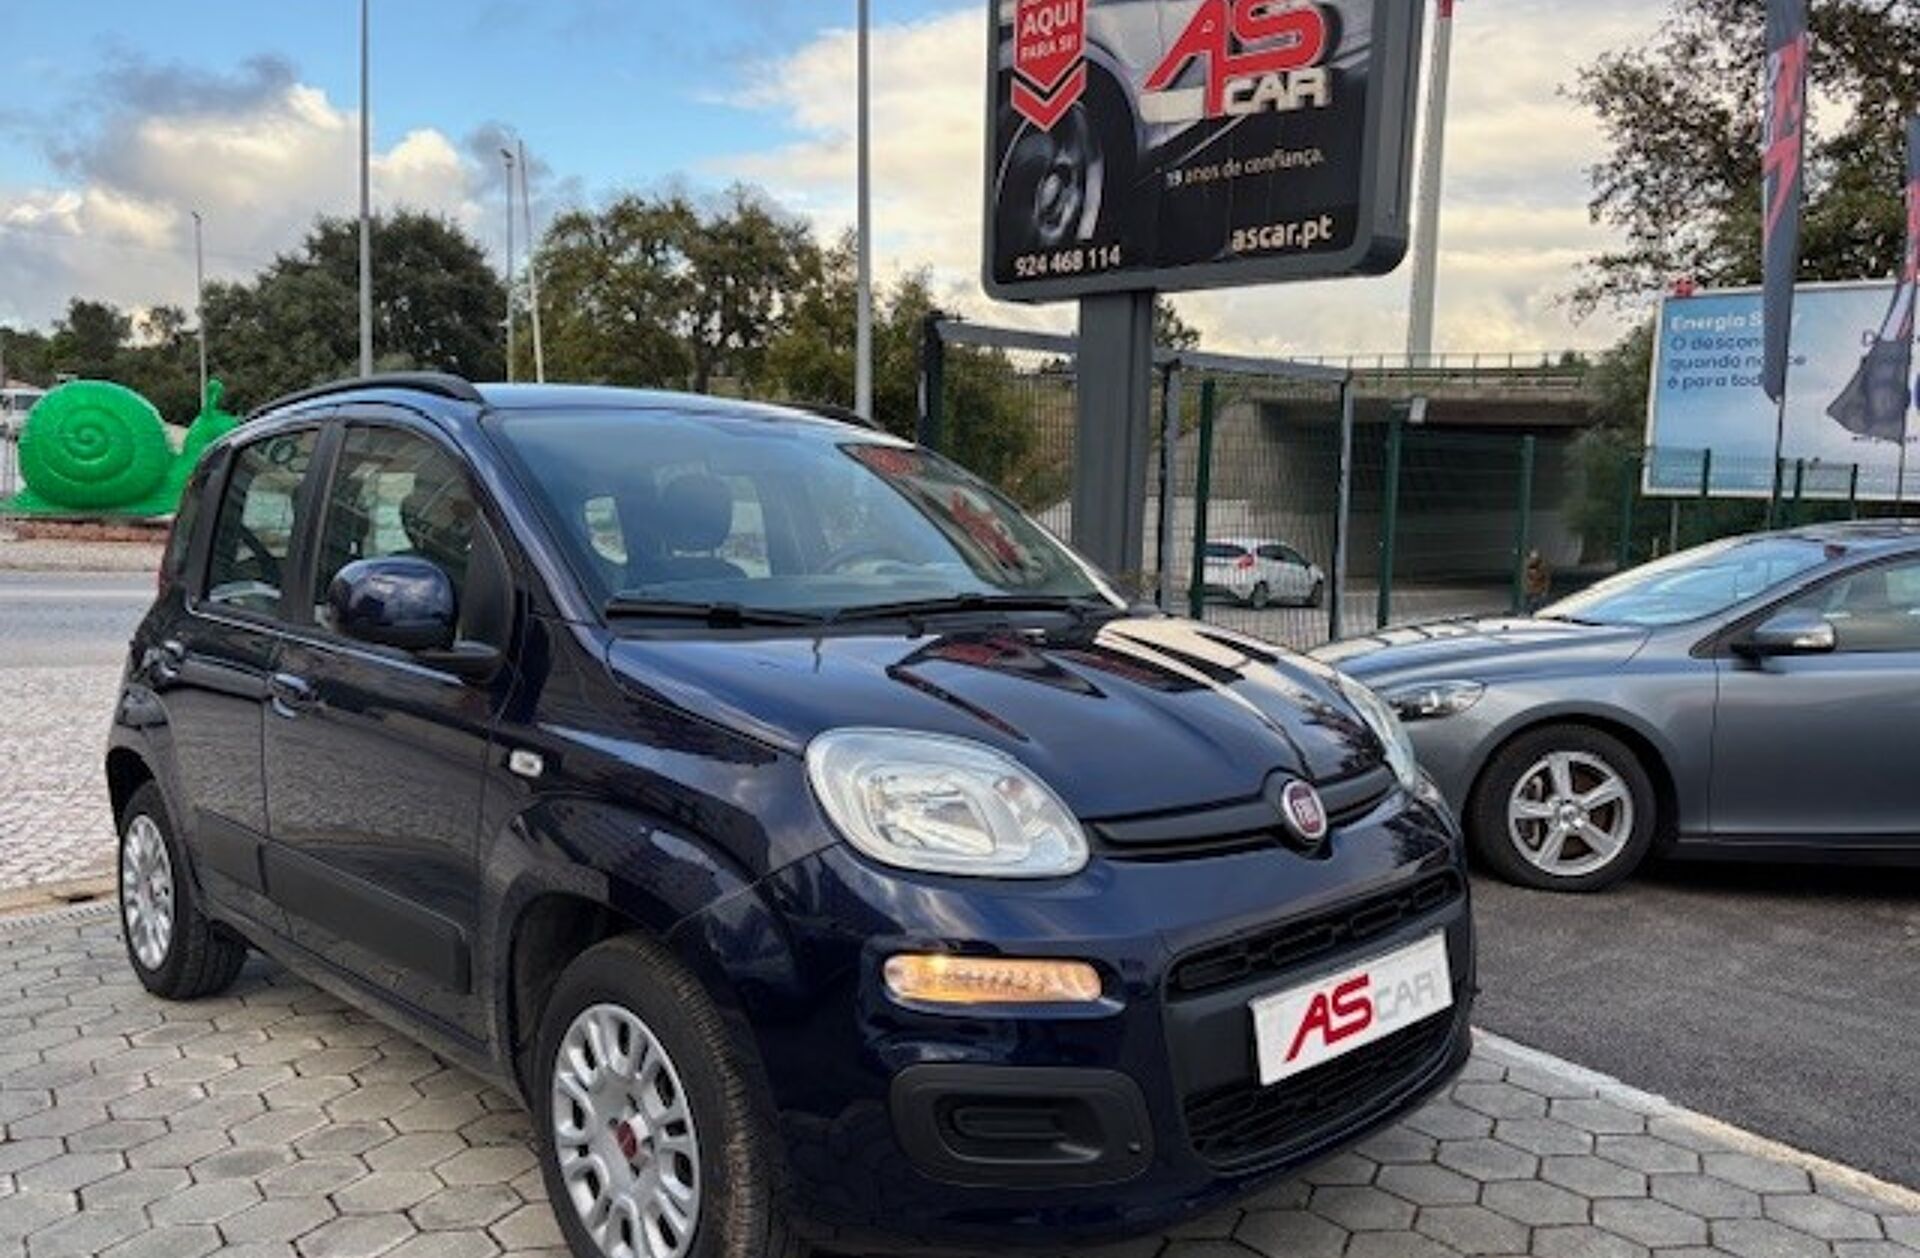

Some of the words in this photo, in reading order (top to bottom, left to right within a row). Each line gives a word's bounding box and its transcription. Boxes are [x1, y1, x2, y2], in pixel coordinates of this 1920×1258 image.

[1021, 0, 1077, 37] AQUI
[1020, 40, 1057, 59] PARA
[1225, 66, 1327, 115] CAR
[1185, 165, 1219, 184] anos
[1223, 158, 1241, 179] de
[1232, 214, 1334, 250] ascar.pt
[1015, 255, 1048, 277] 924
[1050, 249, 1083, 273] 468
[1088, 244, 1120, 270] 114
[1670, 312, 1746, 332] Energia
[1670, 336, 1687, 351] O
[1668, 356, 1741, 373] quando
[1682, 376, 1727, 391] para
